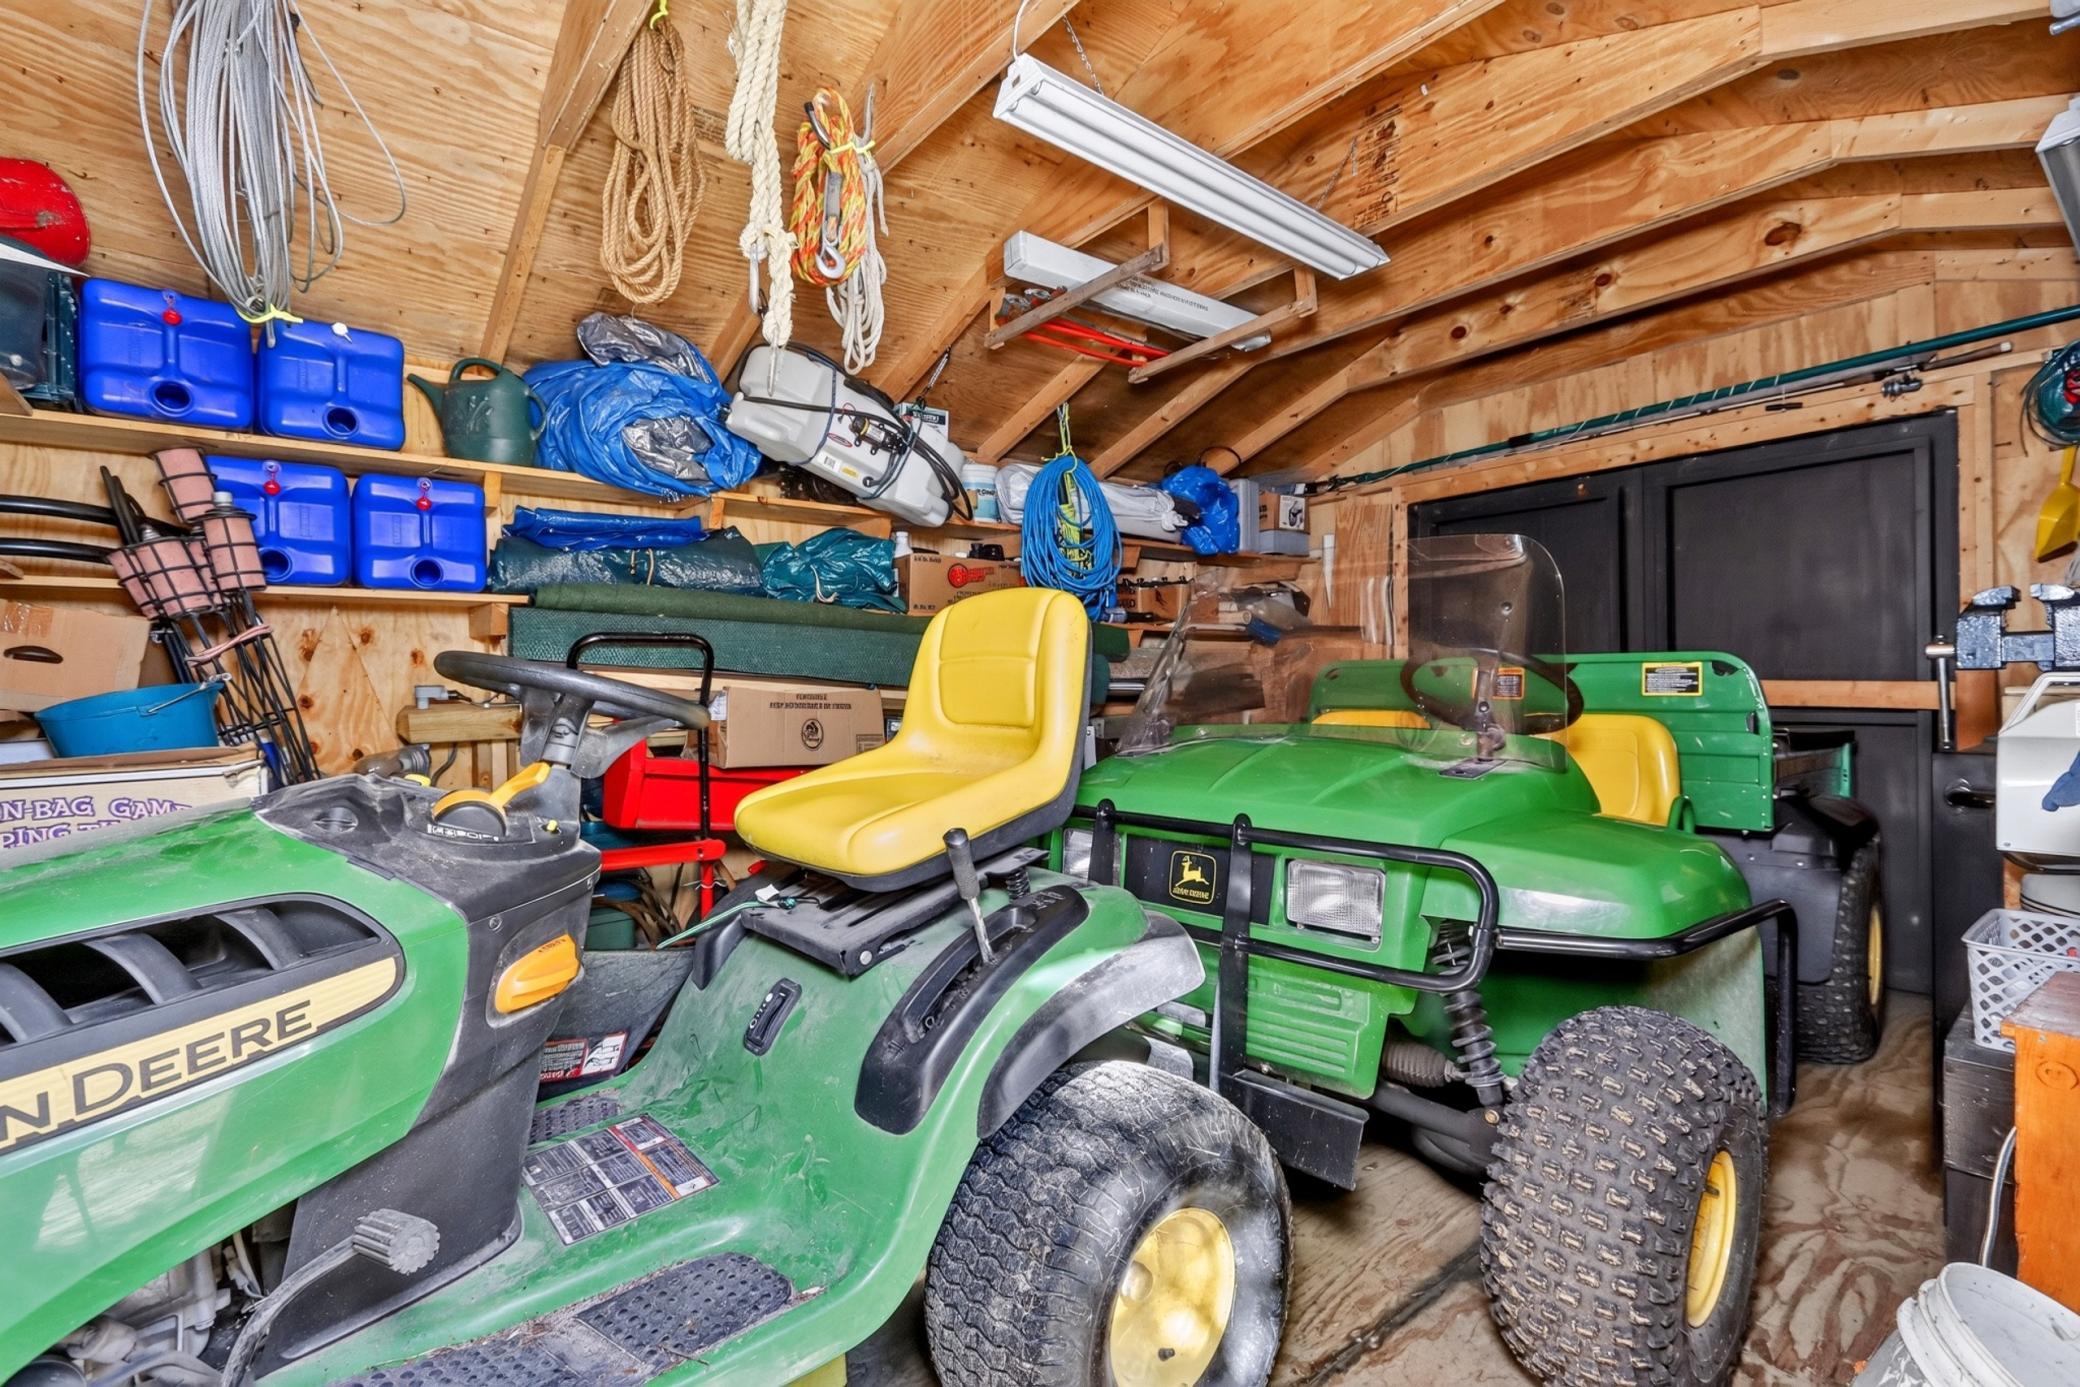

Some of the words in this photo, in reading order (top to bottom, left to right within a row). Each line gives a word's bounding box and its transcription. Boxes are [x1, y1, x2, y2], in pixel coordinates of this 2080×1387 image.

[0, 796, 95, 822] N-BAG
[108, 797, 192, 820] GAM
[0, 1091, 50, 1142] N
[72, 1000, 312, 1116] DEERE
